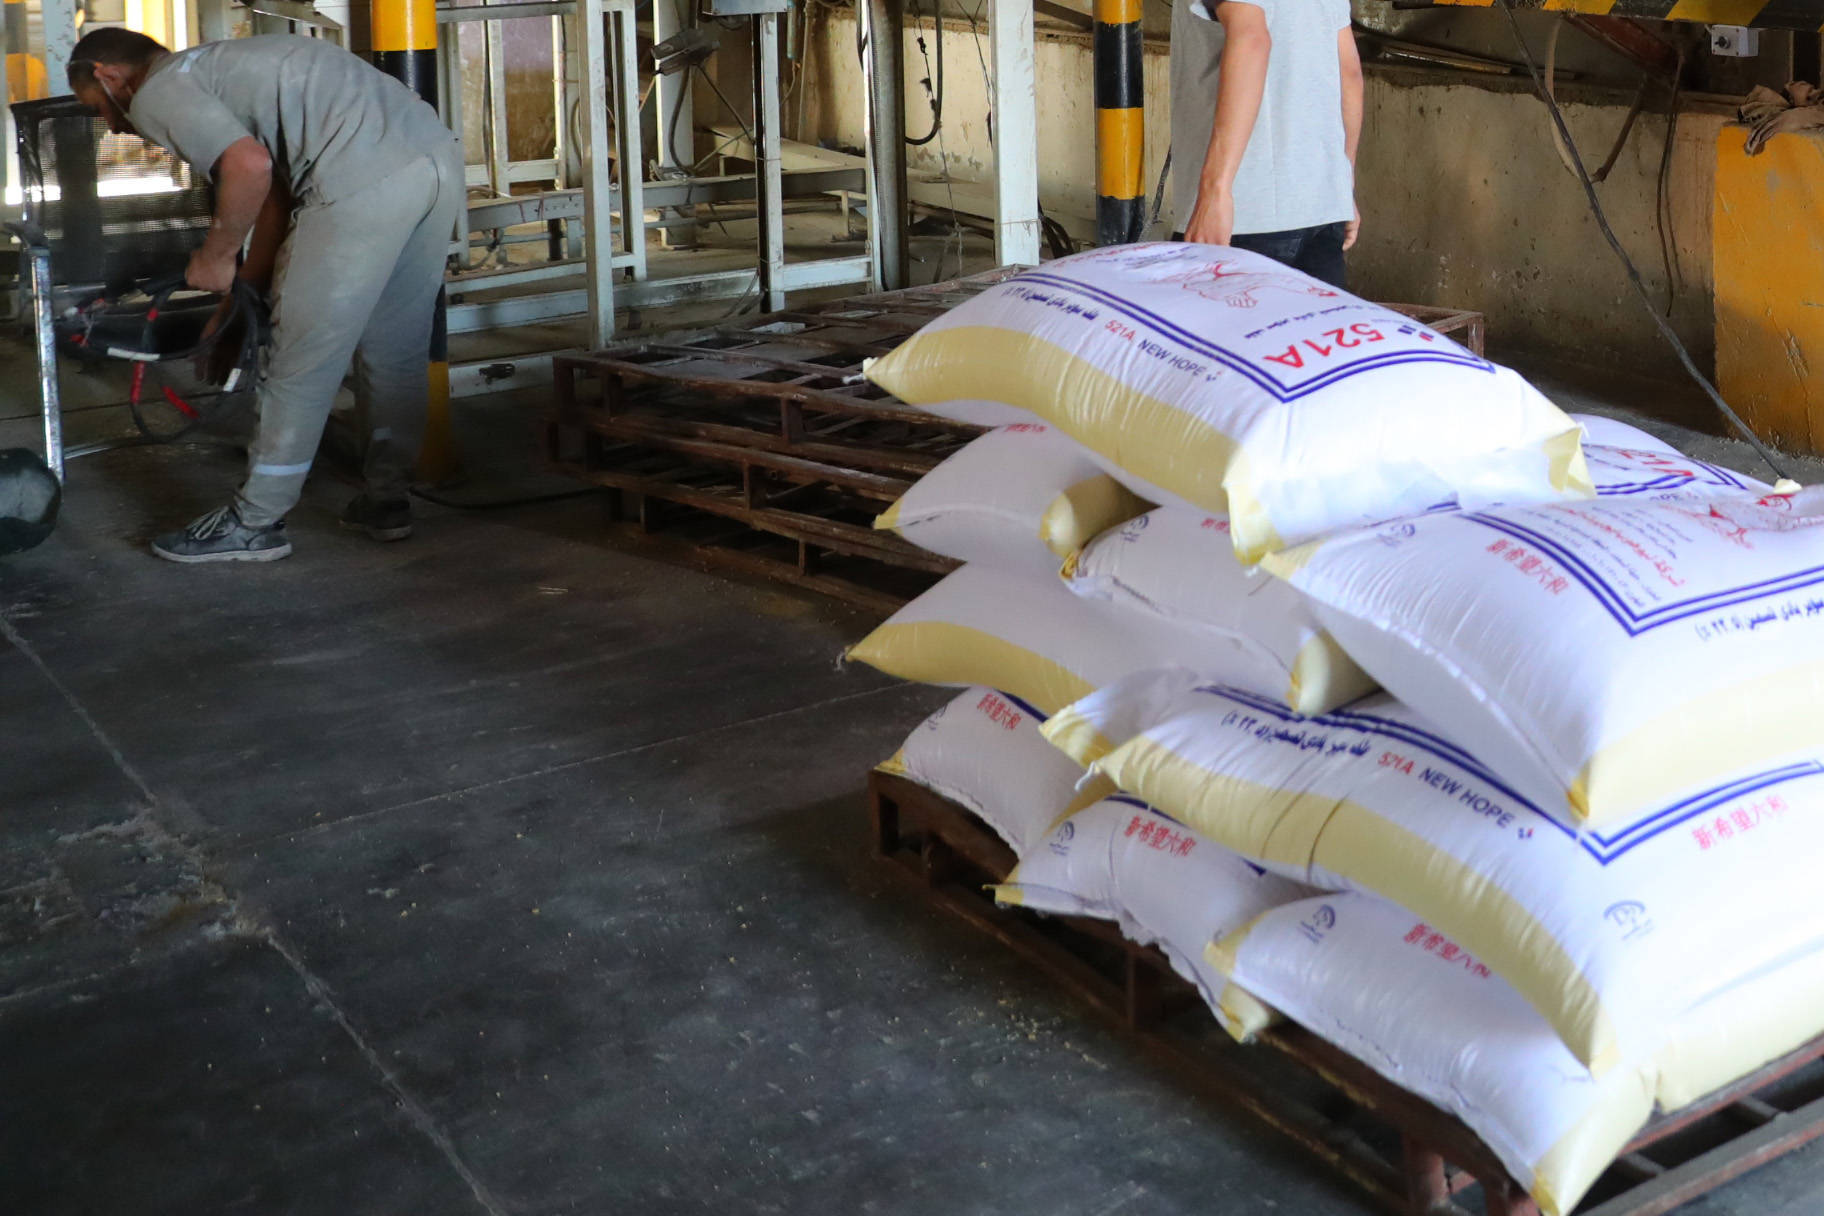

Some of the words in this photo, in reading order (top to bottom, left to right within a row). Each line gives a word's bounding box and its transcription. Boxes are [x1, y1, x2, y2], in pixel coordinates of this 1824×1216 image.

[1104, 319, 1136, 341] 521A
[1138, 338, 1171, 360] NEW
[1169, 355, 1206, 377] HOPE
[1264, 323, 1385, 368] 521A
[1418, 767, 1461, 796] NEW
[1459, 788, 1516, 828] HOPE
